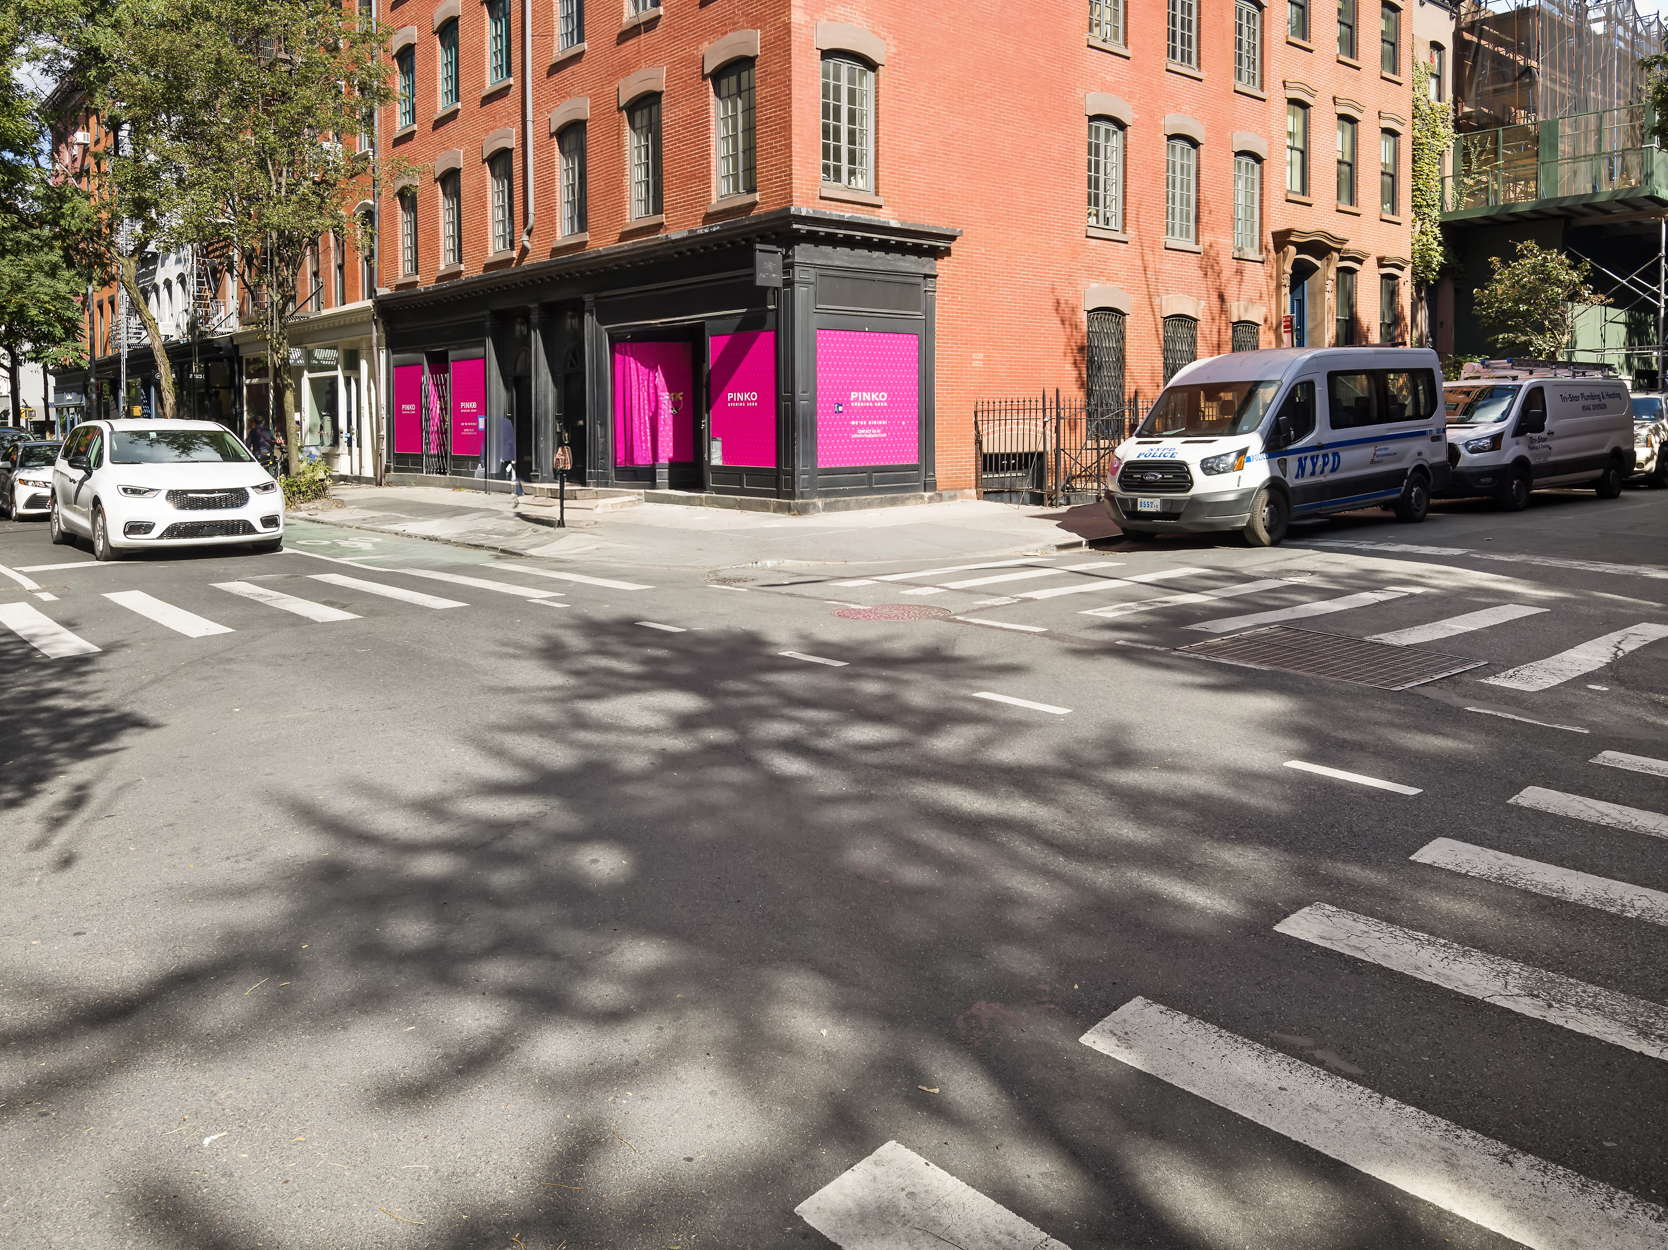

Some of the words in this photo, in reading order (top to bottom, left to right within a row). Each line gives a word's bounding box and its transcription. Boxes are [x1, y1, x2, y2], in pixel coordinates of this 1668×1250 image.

[728, 392, 758, 401] PINKO
[851, 392, 887, 401] PINKO
[1560, 392, 1580, 402] Tri-Star
[1580, 392, 1601, 402] Plumbing
[1605, 391, 1621, 400] Heating
[1251, 453, 1268, 461] POLICE
[1295, 452, 1341, 479] NYPD
